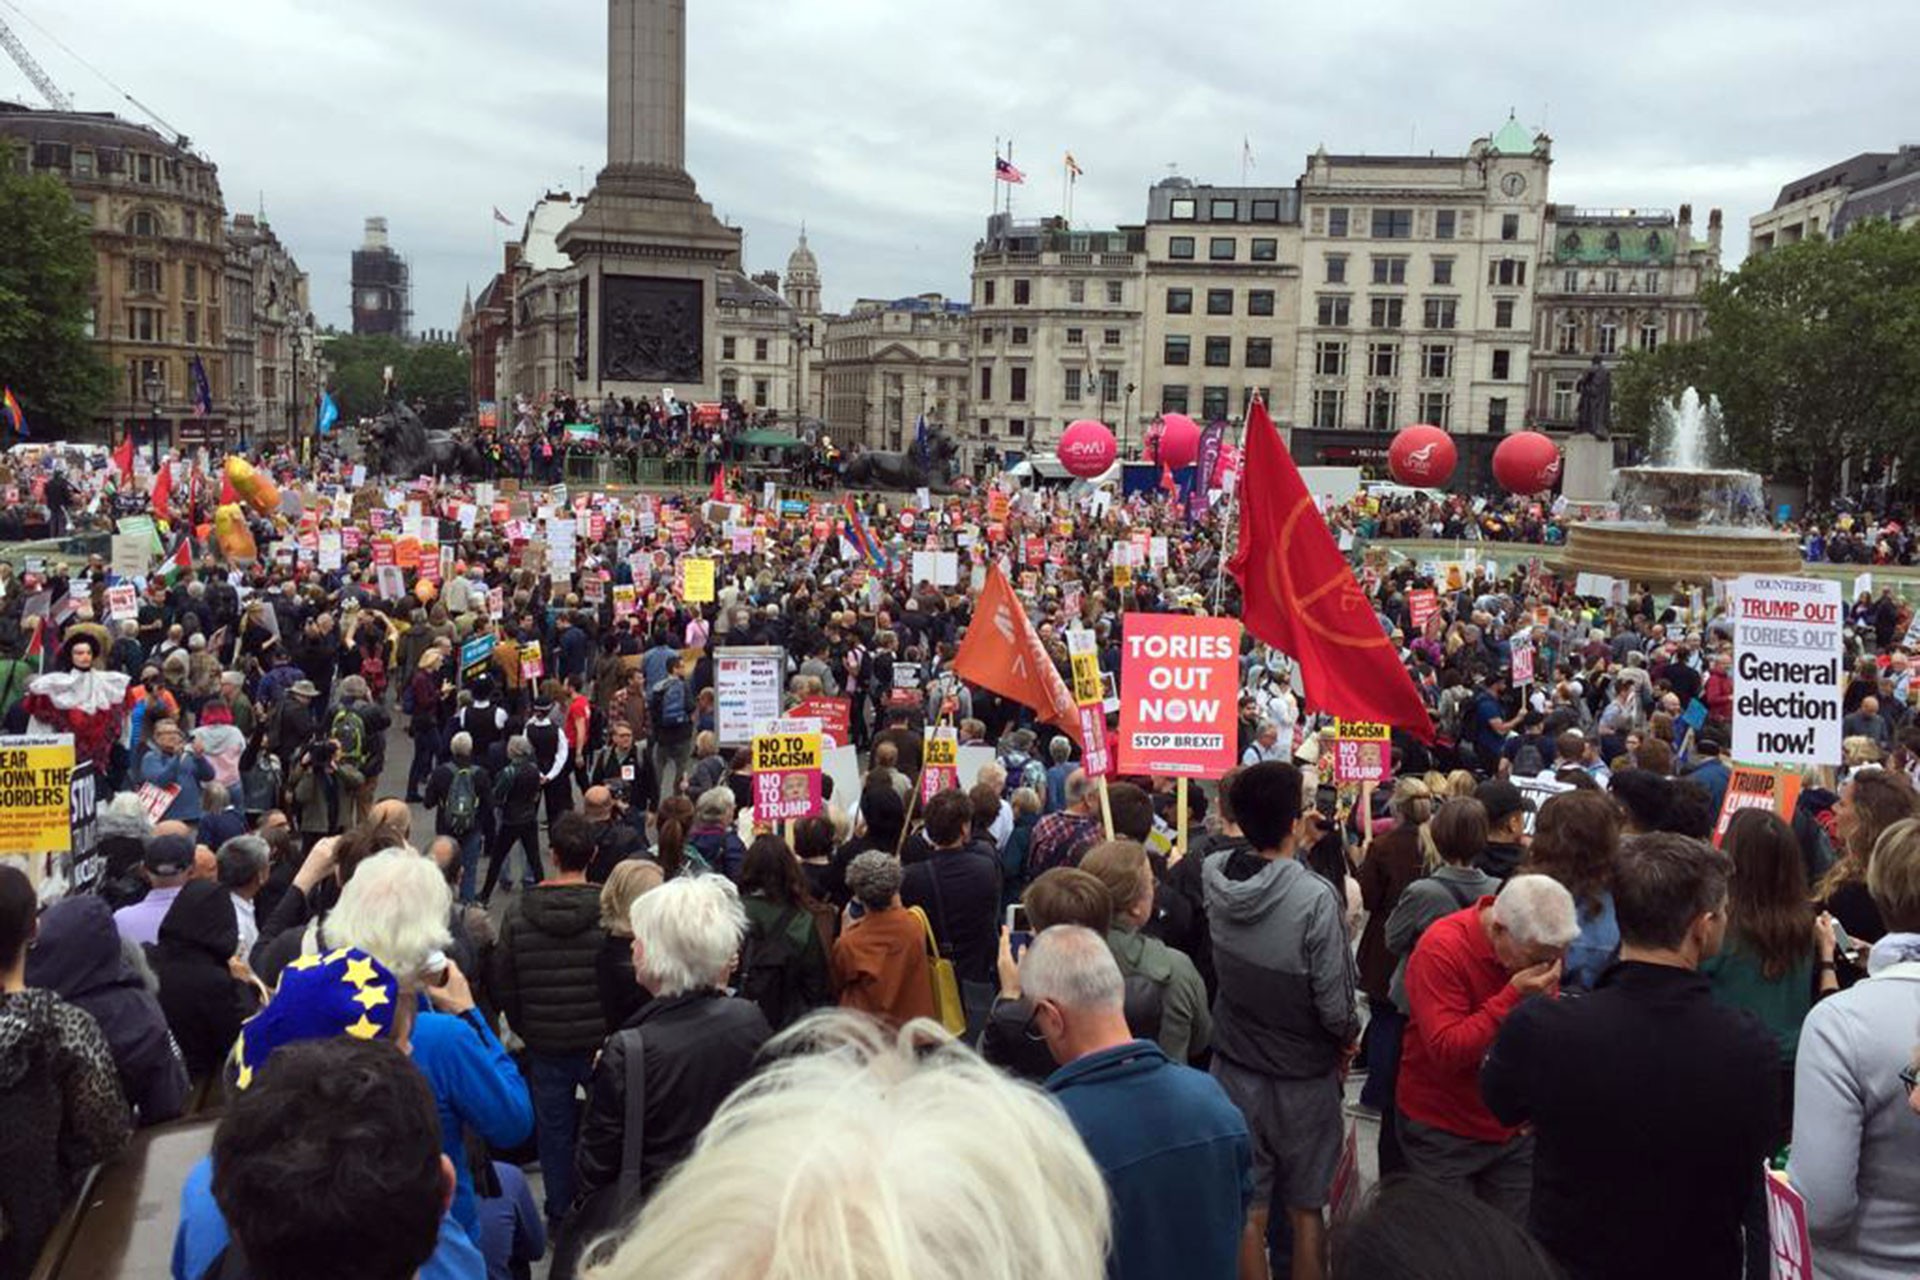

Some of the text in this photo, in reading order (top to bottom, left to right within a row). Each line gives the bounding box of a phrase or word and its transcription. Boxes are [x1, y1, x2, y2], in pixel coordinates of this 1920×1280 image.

[1754, 580, 1826, 594] COUNTERFIRE
[1741, 598, 1837, 620] TRUMP OUT
[1740, 626, 1837, 647] TORIES OUT
[1127, 635, 1233, 660] TORIES
[1738, 653, 1837, 685] General
[1149, 667, 1213, 691] OUT
[1139, 699, 1220, 723] NOW
[1737, 688, 1837, 720] election
[1340, 725, 1385, 737] RACISM
[759, 737, 804, 753] NO TO
[1134, 736, 1222, 747] STOP BREXIT
[1339, 741, 1358, 754] NO
[1757, 727, 1815, 755] now!
[759, 752, 814, 768] RACISM
[1339, 754, 1357, 767] TO
[0, 767, 71, 789] OWN THE
[1339, 766, 1383, 778] TRUMP
[759, 773, 781, 789] NO
[759, 788, 780, 803] TO
[759, 800, 812, 818] TRUMP
